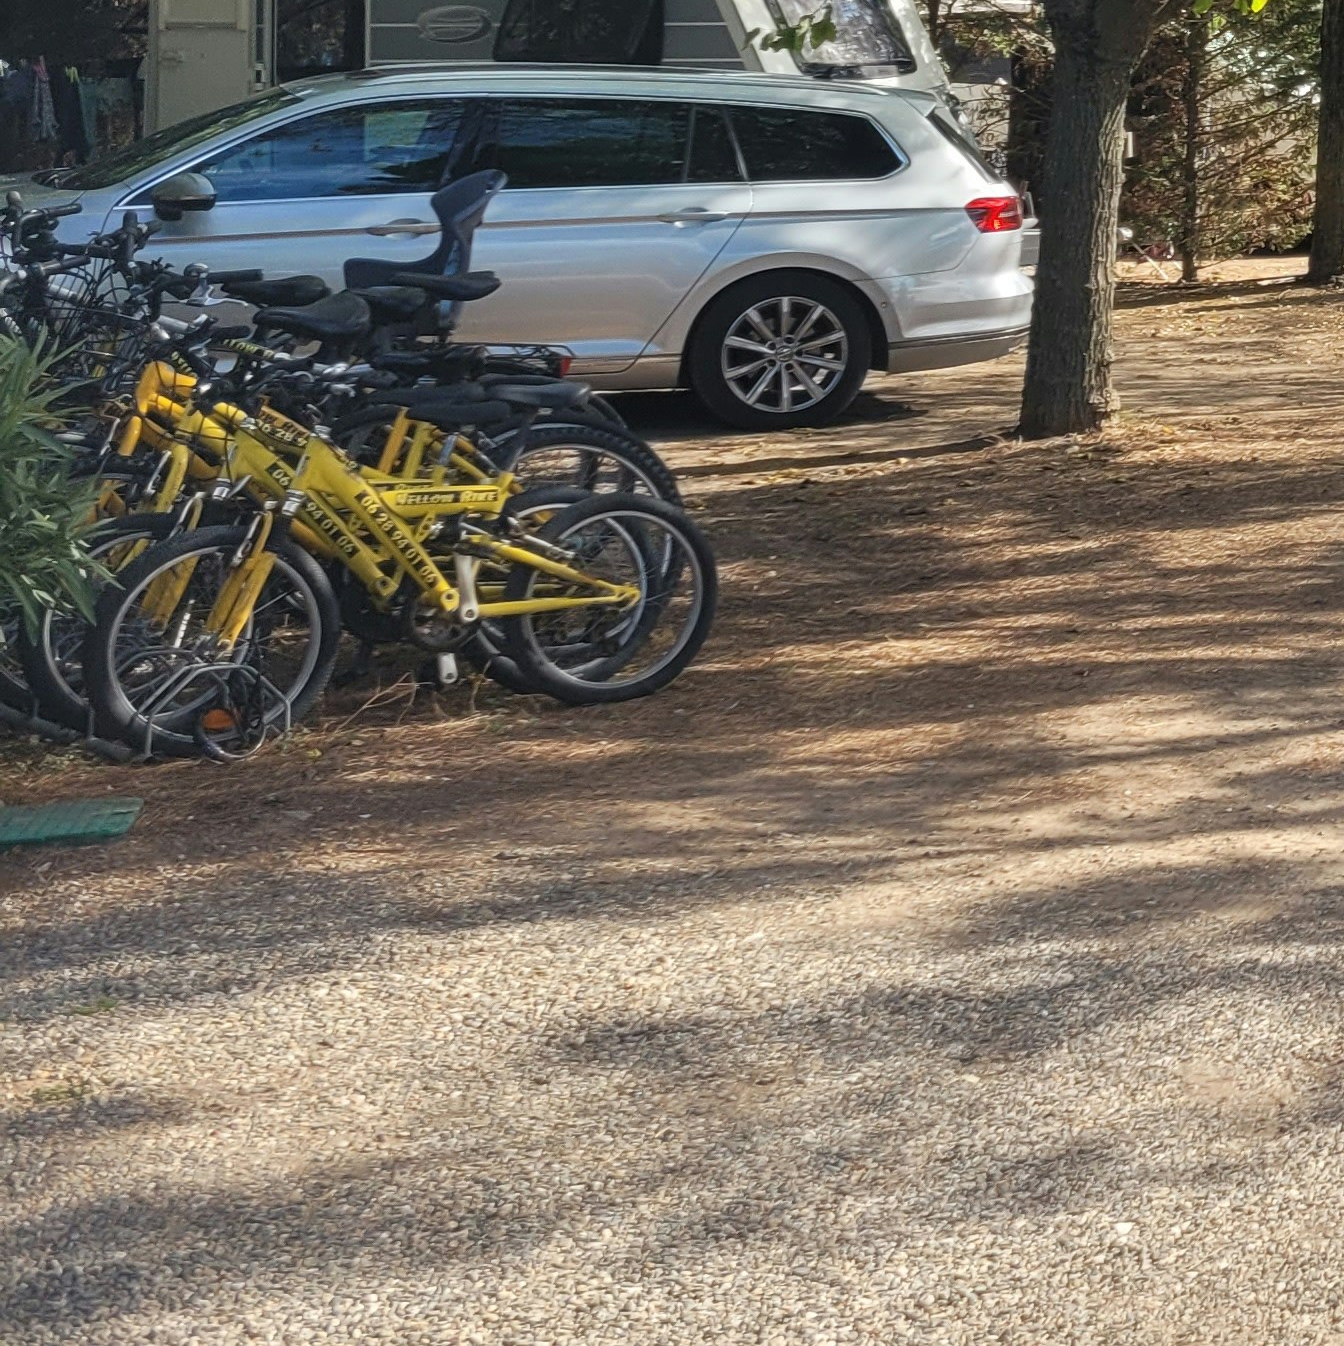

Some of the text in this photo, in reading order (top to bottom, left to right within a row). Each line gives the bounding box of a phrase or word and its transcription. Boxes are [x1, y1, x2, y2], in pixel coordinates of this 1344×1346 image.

[272, 469, 290, 486] 06
[321, 517, 337, 535] 01
[338, 534, 355, 554] 06
[361, 495, 437, 582] 06 28 94 01 06
